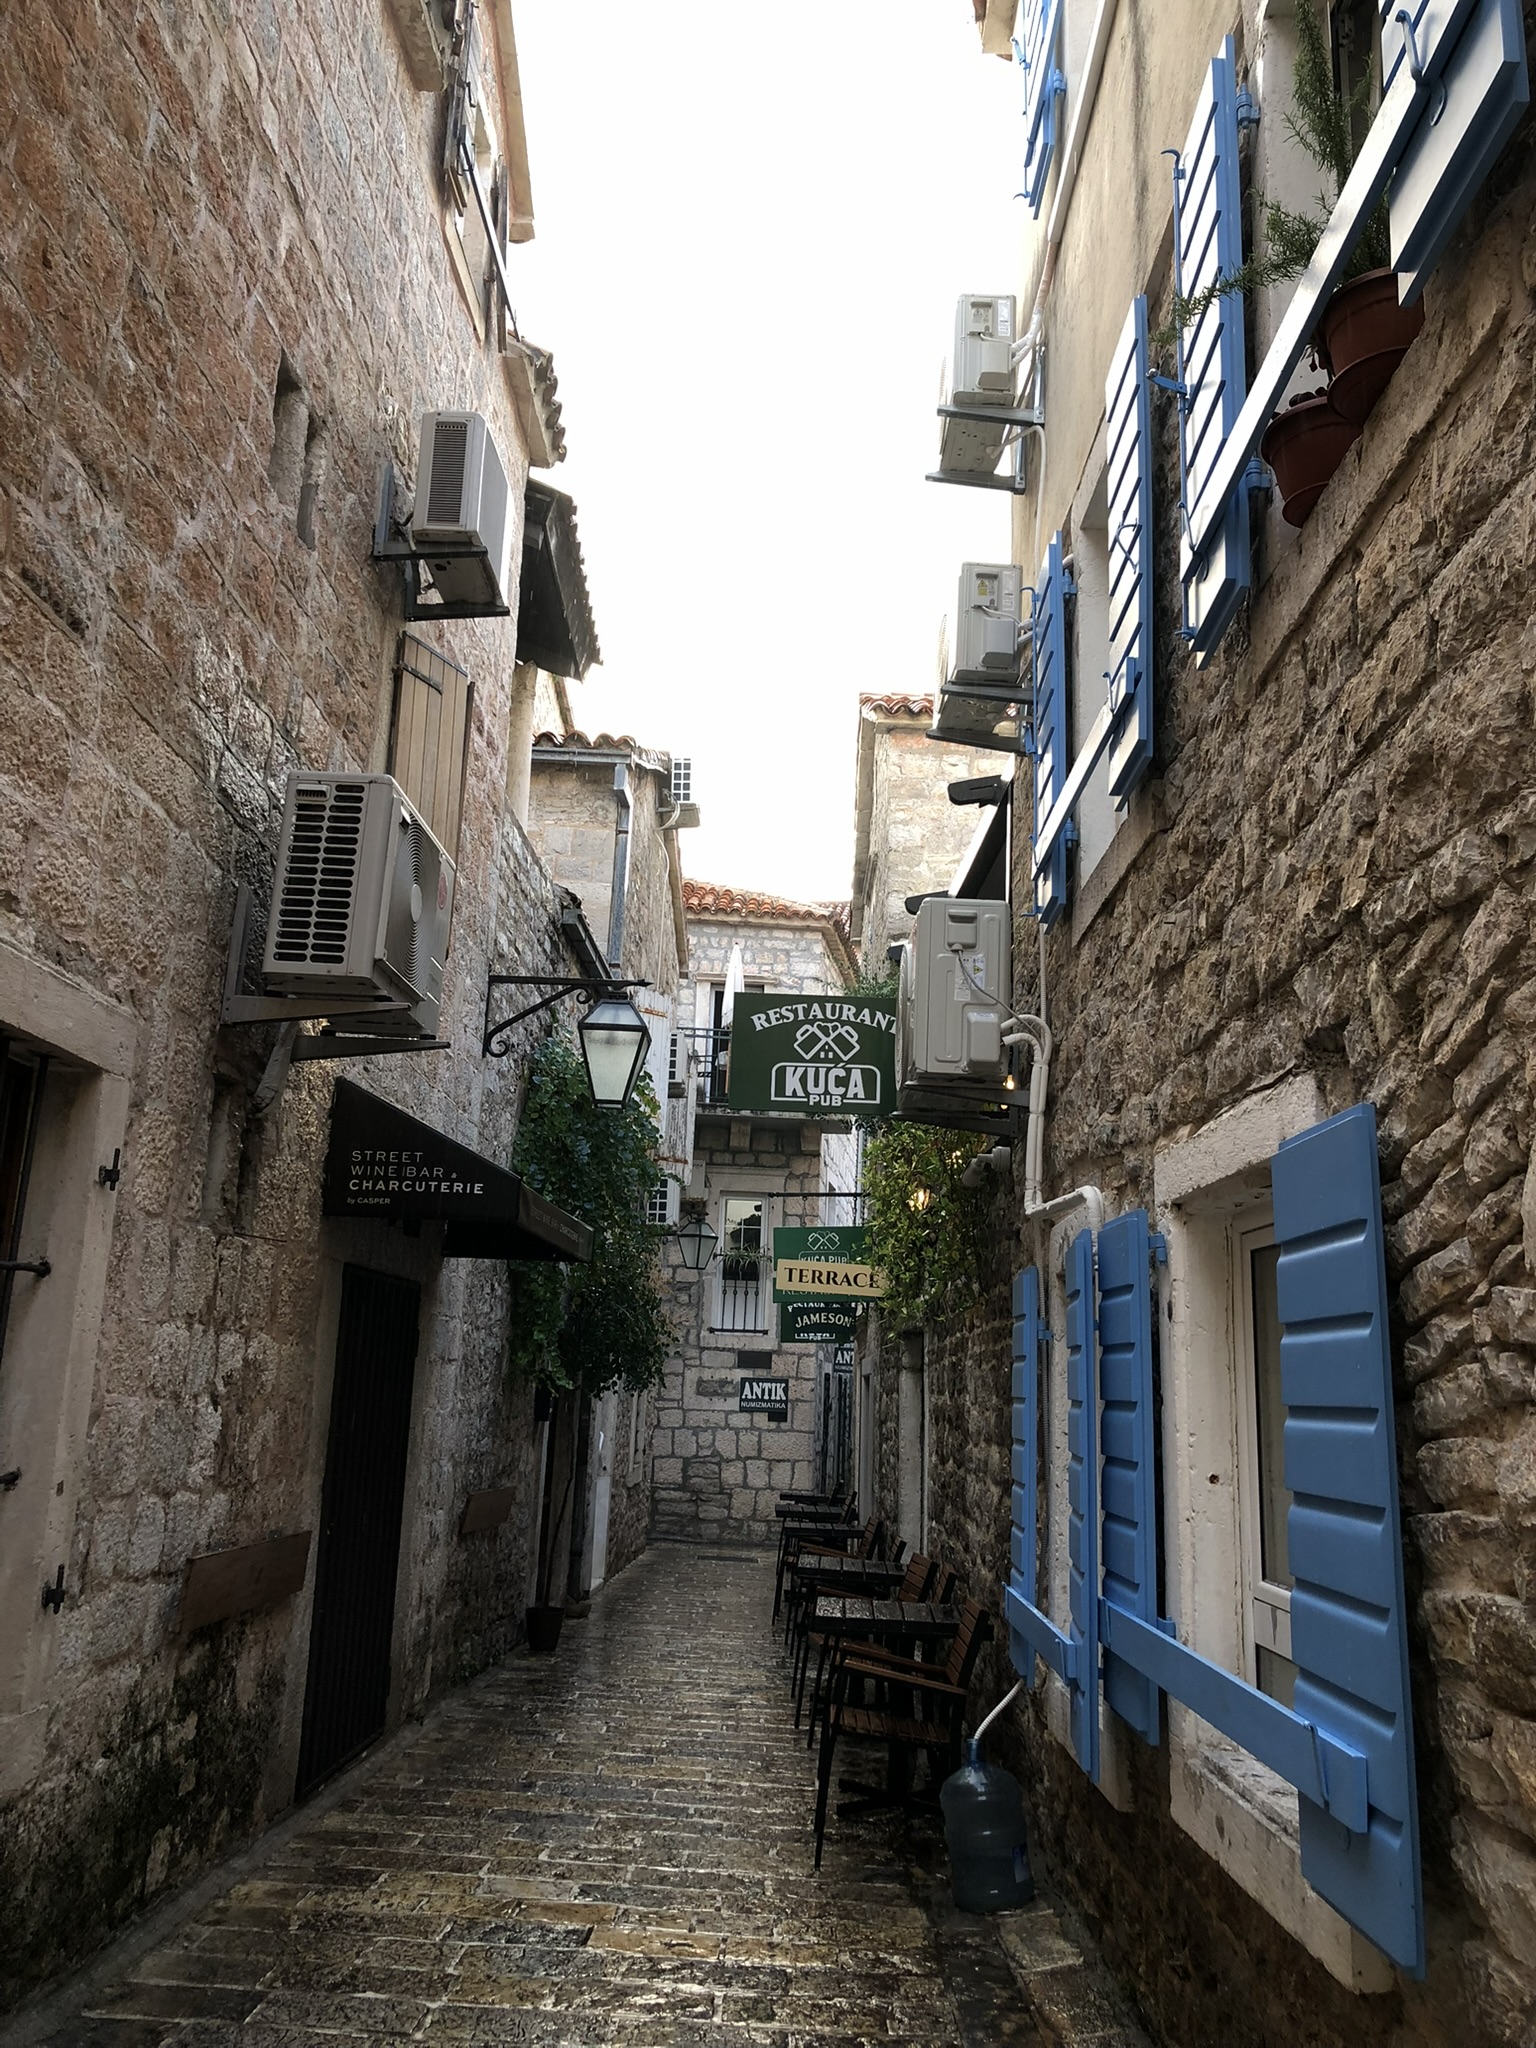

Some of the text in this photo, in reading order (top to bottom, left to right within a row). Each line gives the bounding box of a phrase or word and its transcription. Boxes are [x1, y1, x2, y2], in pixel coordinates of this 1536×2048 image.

[750, 1002, 897, 1035] RESTAURANT
[785, 1062, 866, 1099] KUĆA
[808, 1095, 842, 1107] PUB
[351, 1150, 424, 1163] STREET
[350, 1165, 398, 1177] WINE
[349, 1179, 484, 1194] CHARCUTERIE
[347, 1196, 391, 1205] by CASPER
[784, 1266, 880, 1289] TERRACE
[795, 1312, 852, 1328] JAMESON
[741, 1381, 787, 1400] ANTIK
[740, 1401, 786, 1409] NUMIZMATIKA
